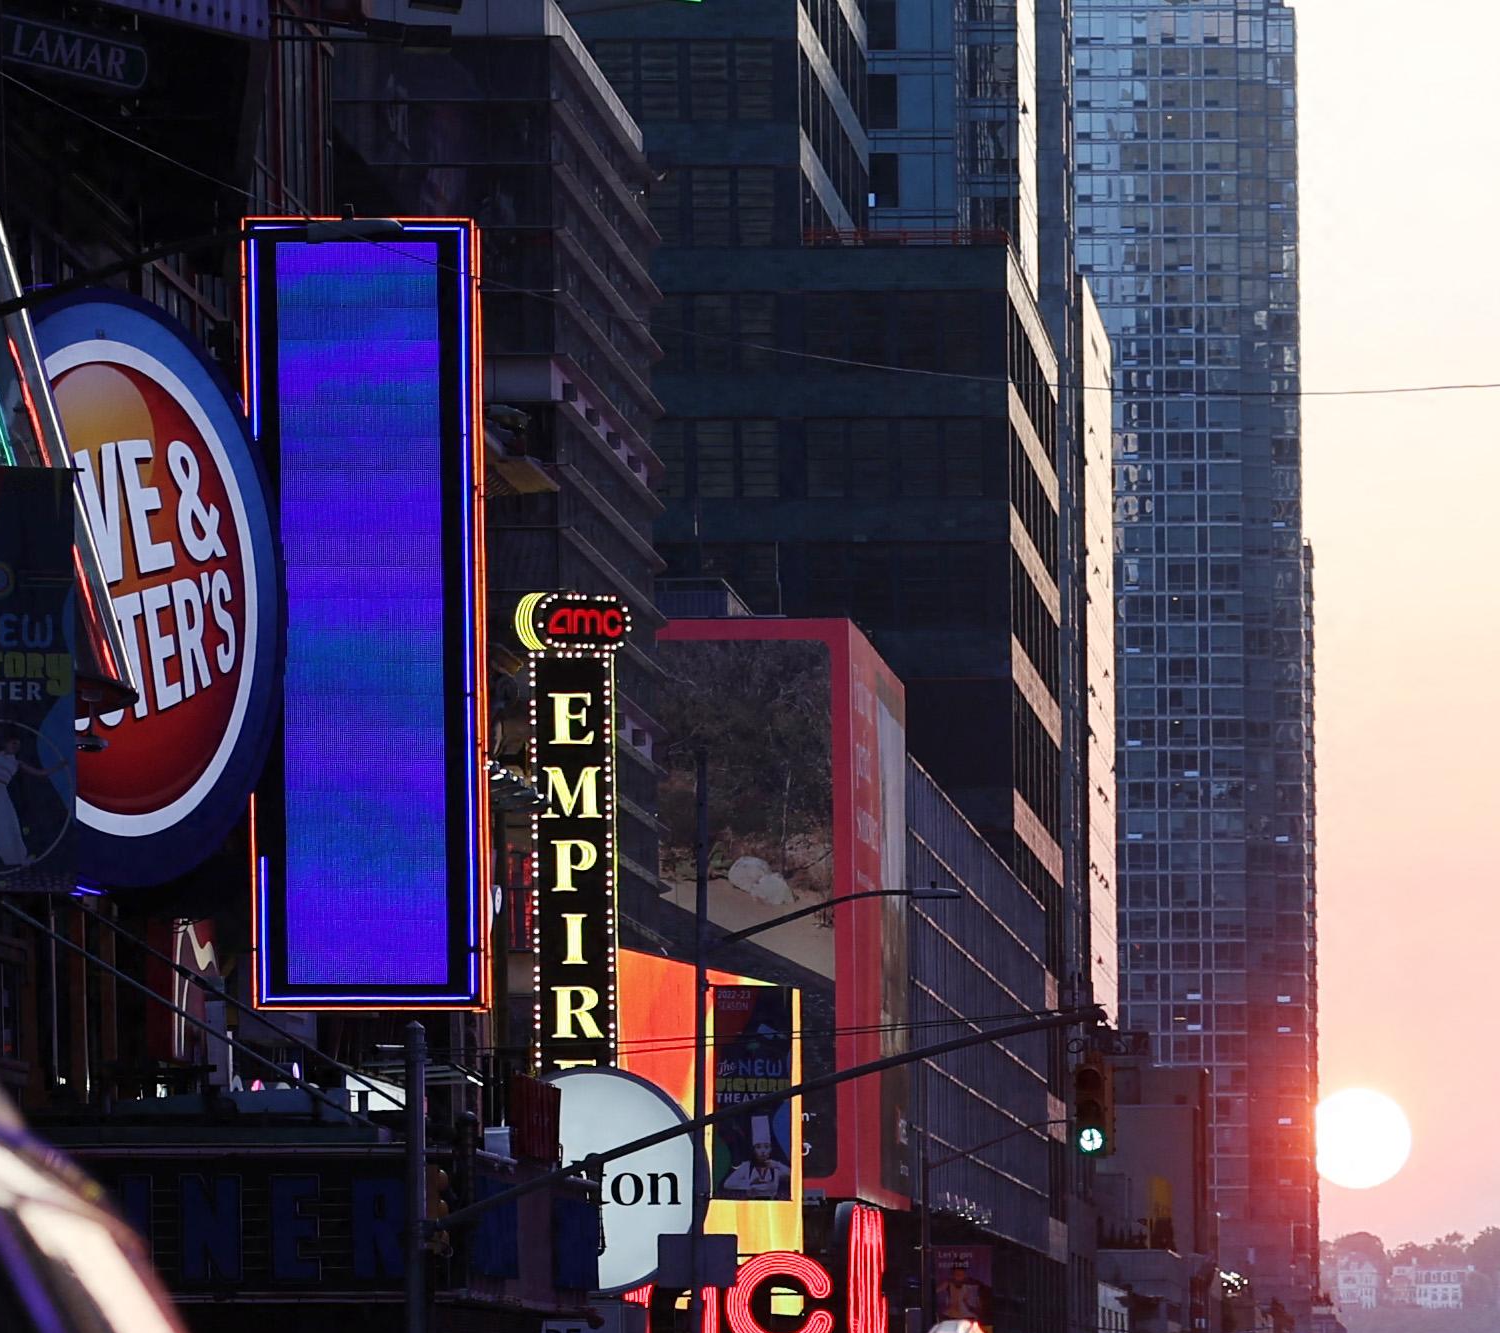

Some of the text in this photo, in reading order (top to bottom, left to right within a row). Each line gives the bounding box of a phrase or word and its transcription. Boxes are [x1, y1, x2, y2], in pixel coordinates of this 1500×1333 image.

[13, 24, 126, 81] LAMAR
[166, 440, 228, 563] &
[542, 690, 605, 1070] EMPIR
